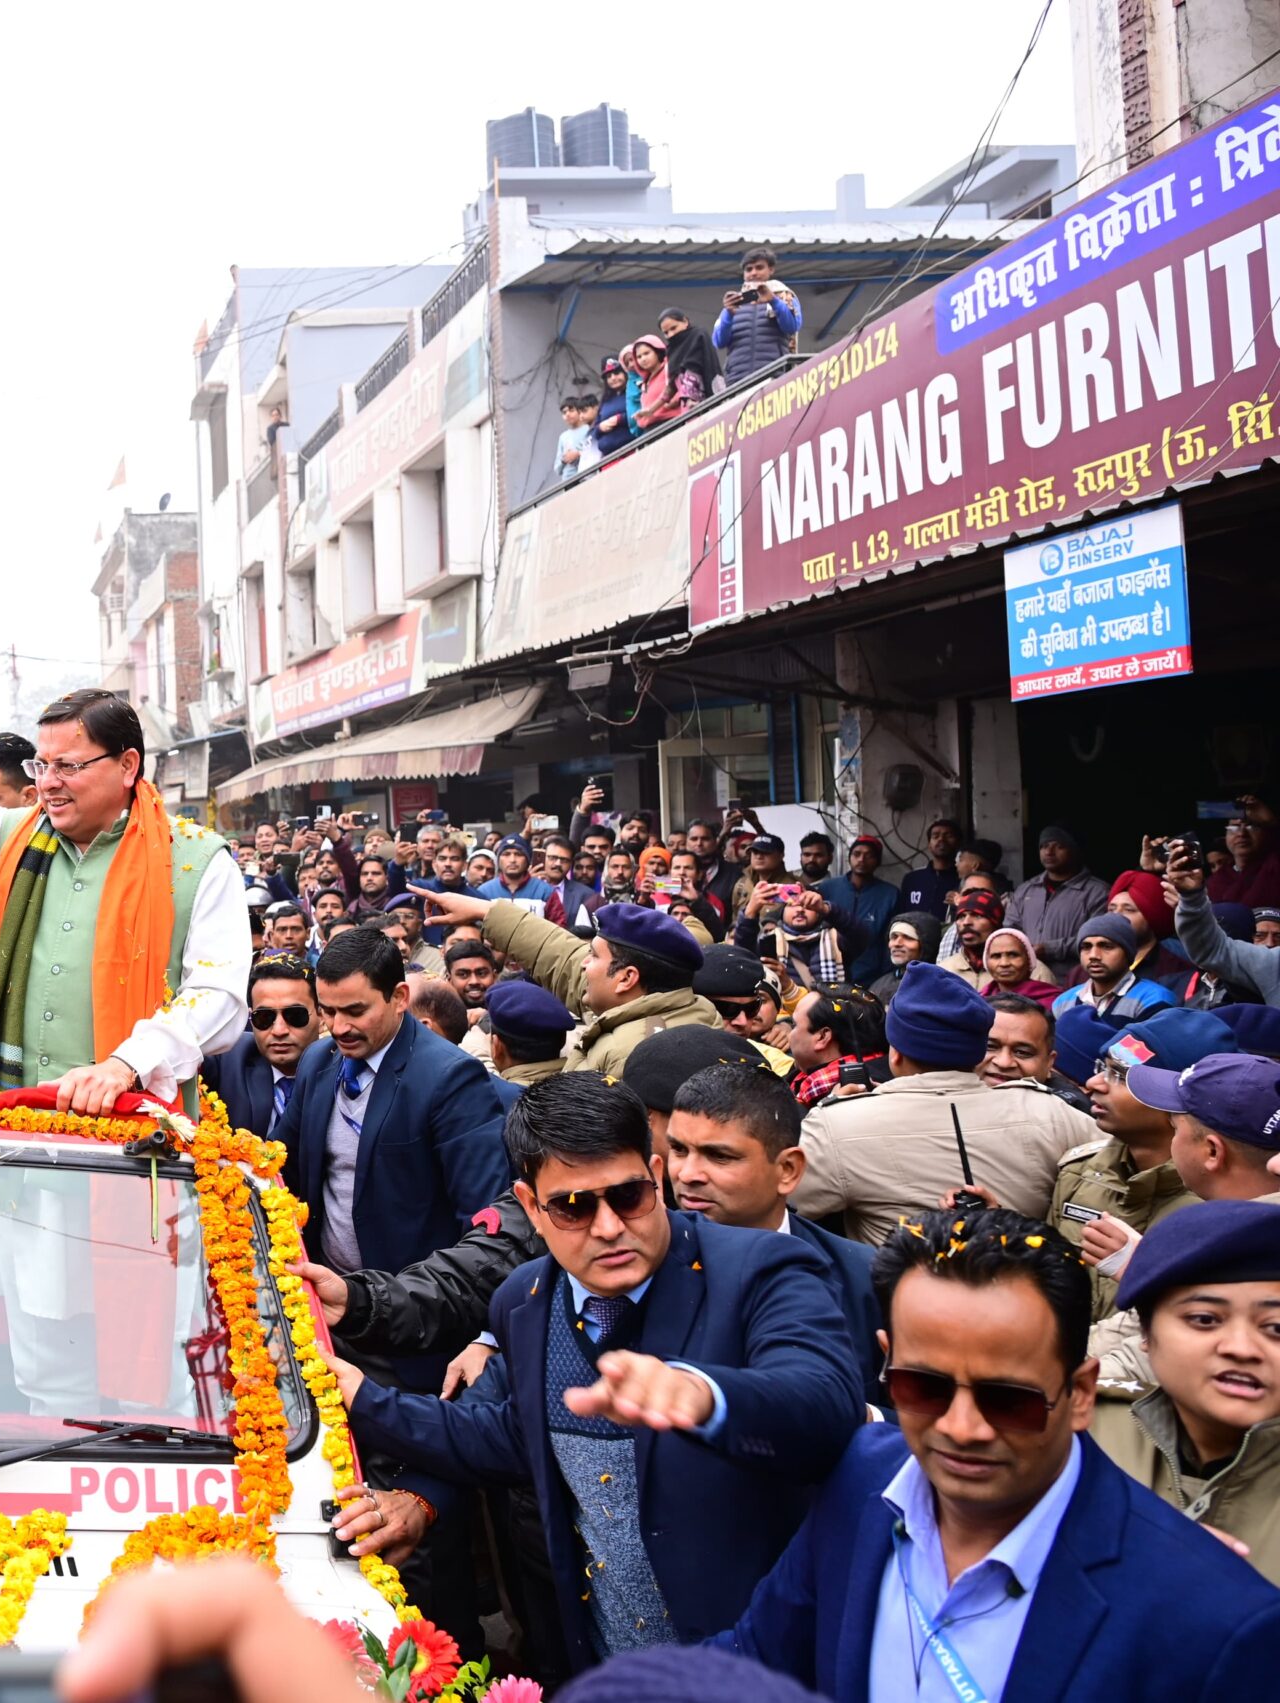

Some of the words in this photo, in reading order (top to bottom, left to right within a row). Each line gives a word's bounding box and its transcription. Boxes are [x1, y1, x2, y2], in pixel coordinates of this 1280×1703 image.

[950, 239, 1058, 333] अधिकृत
[1064, 173, 1177, 272] विक्रेता
[688, 421, 725, 466] GSTIN
[760, 373, 963, 551] NARANG
[802, 552, 836, 584] पता
[904, 508, 960, 551] गल्ला
[964, 485, 1010, 531] मंडी
[1067, 523, 1133, 553] BAJAJ
[1068, 540, 1134, 569] FINSERV
[1014, 587, 1045, 623] हमारे
[1047, 579, 1071, 614] यहाँ
[1073, 577, 1114, 607] बजाज
[1020, 627, 1037, 658] की
[1040, 622, 1078, 667] सुविधा
[1080, 615, 1097, 646] भी
[1099, 611, 1148, 644] उपलब्ध
[273, 676, 317, 713] पंजाब
[1016, 677, 1052, 694] आधार
[1088, 663, 1123, 682] उधार
[1125, 657, 1140, 677] ले
